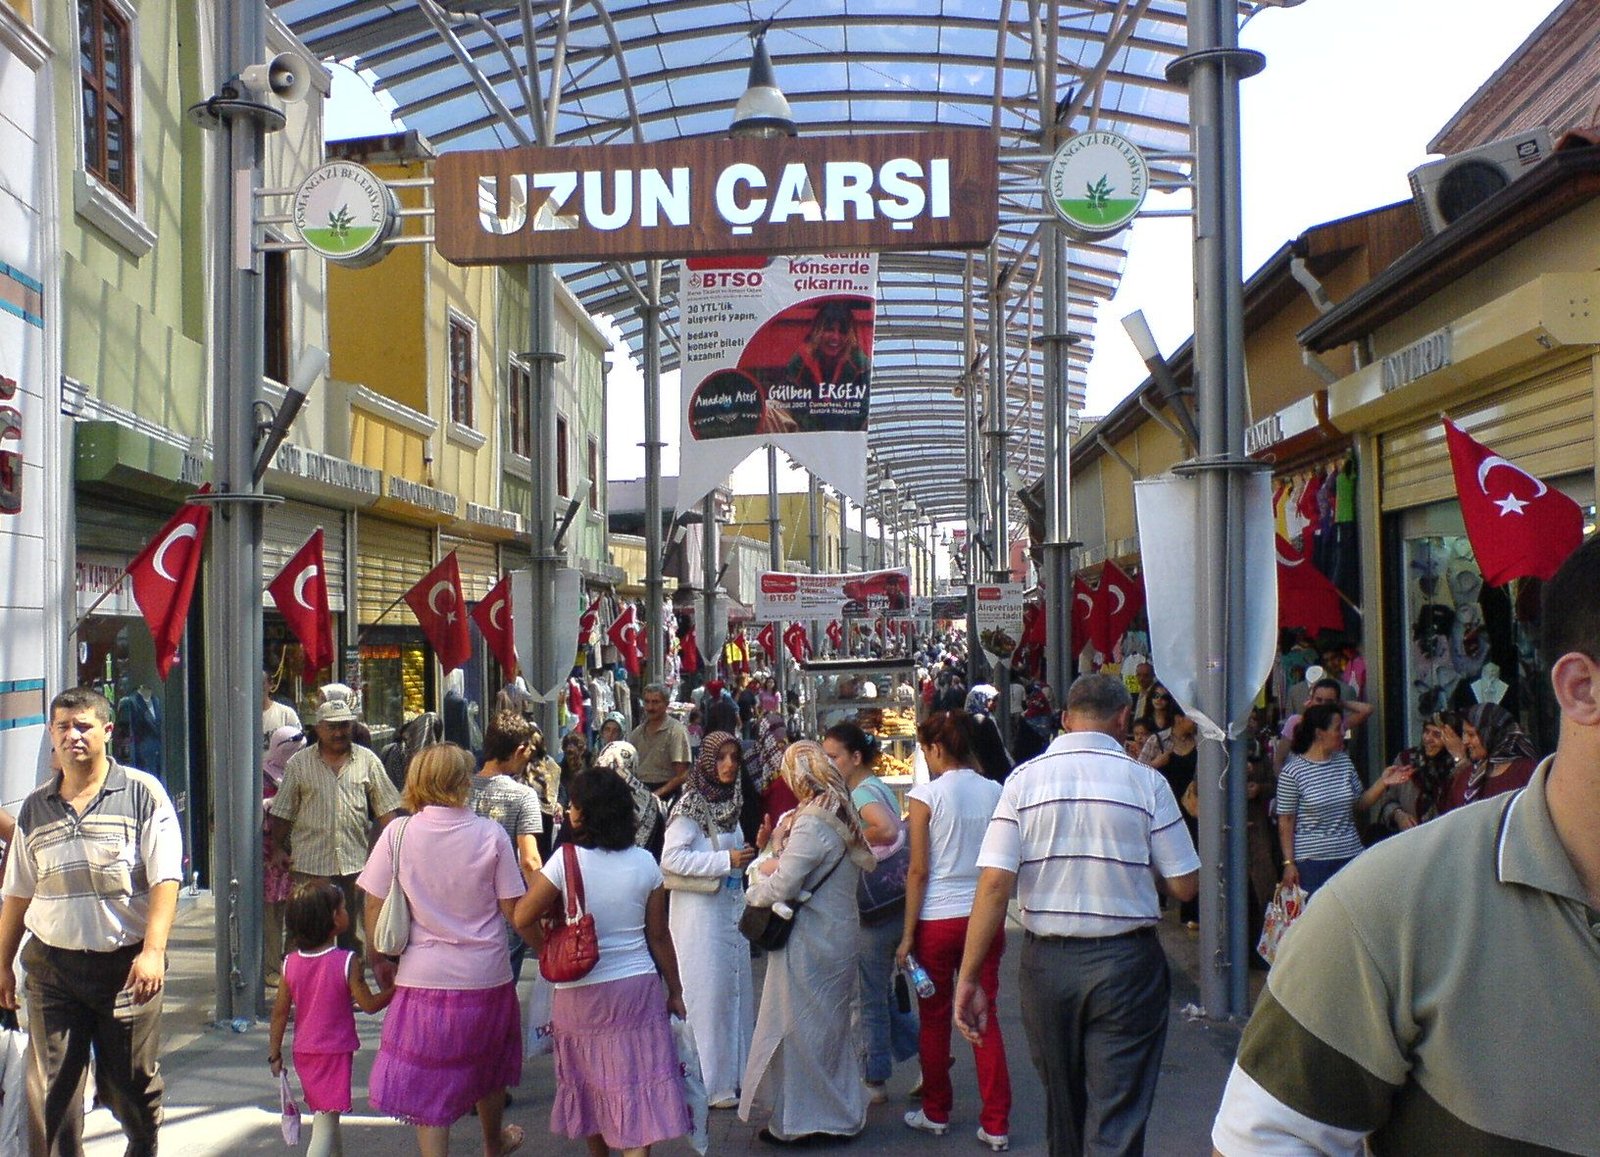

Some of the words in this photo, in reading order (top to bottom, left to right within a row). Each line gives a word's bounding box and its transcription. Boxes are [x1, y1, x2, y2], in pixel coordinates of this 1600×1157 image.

[478, 167, 690, 235] UZUN
[715, 158, 951, 235] ÇARŞI
[788, 261, 870, 275] konserde
[703, 272, 763, 288] BTSO
[794, 276, 868, 291] çıkarın...
[687, 313, 727, 325] alışveriş
[687, 330, 719, 340] bedava
[687, 341, 718, 352] konser
[720, 338, 744, 347] bileti
[687, 350, 725, 362] kazanın!
[768, 384, 812, 400] Gülben
[819, 382, 867, 400] ERGEN
[695, 393, 732, 407] Anadolu
[769, 593, 797, 602] BTSO
